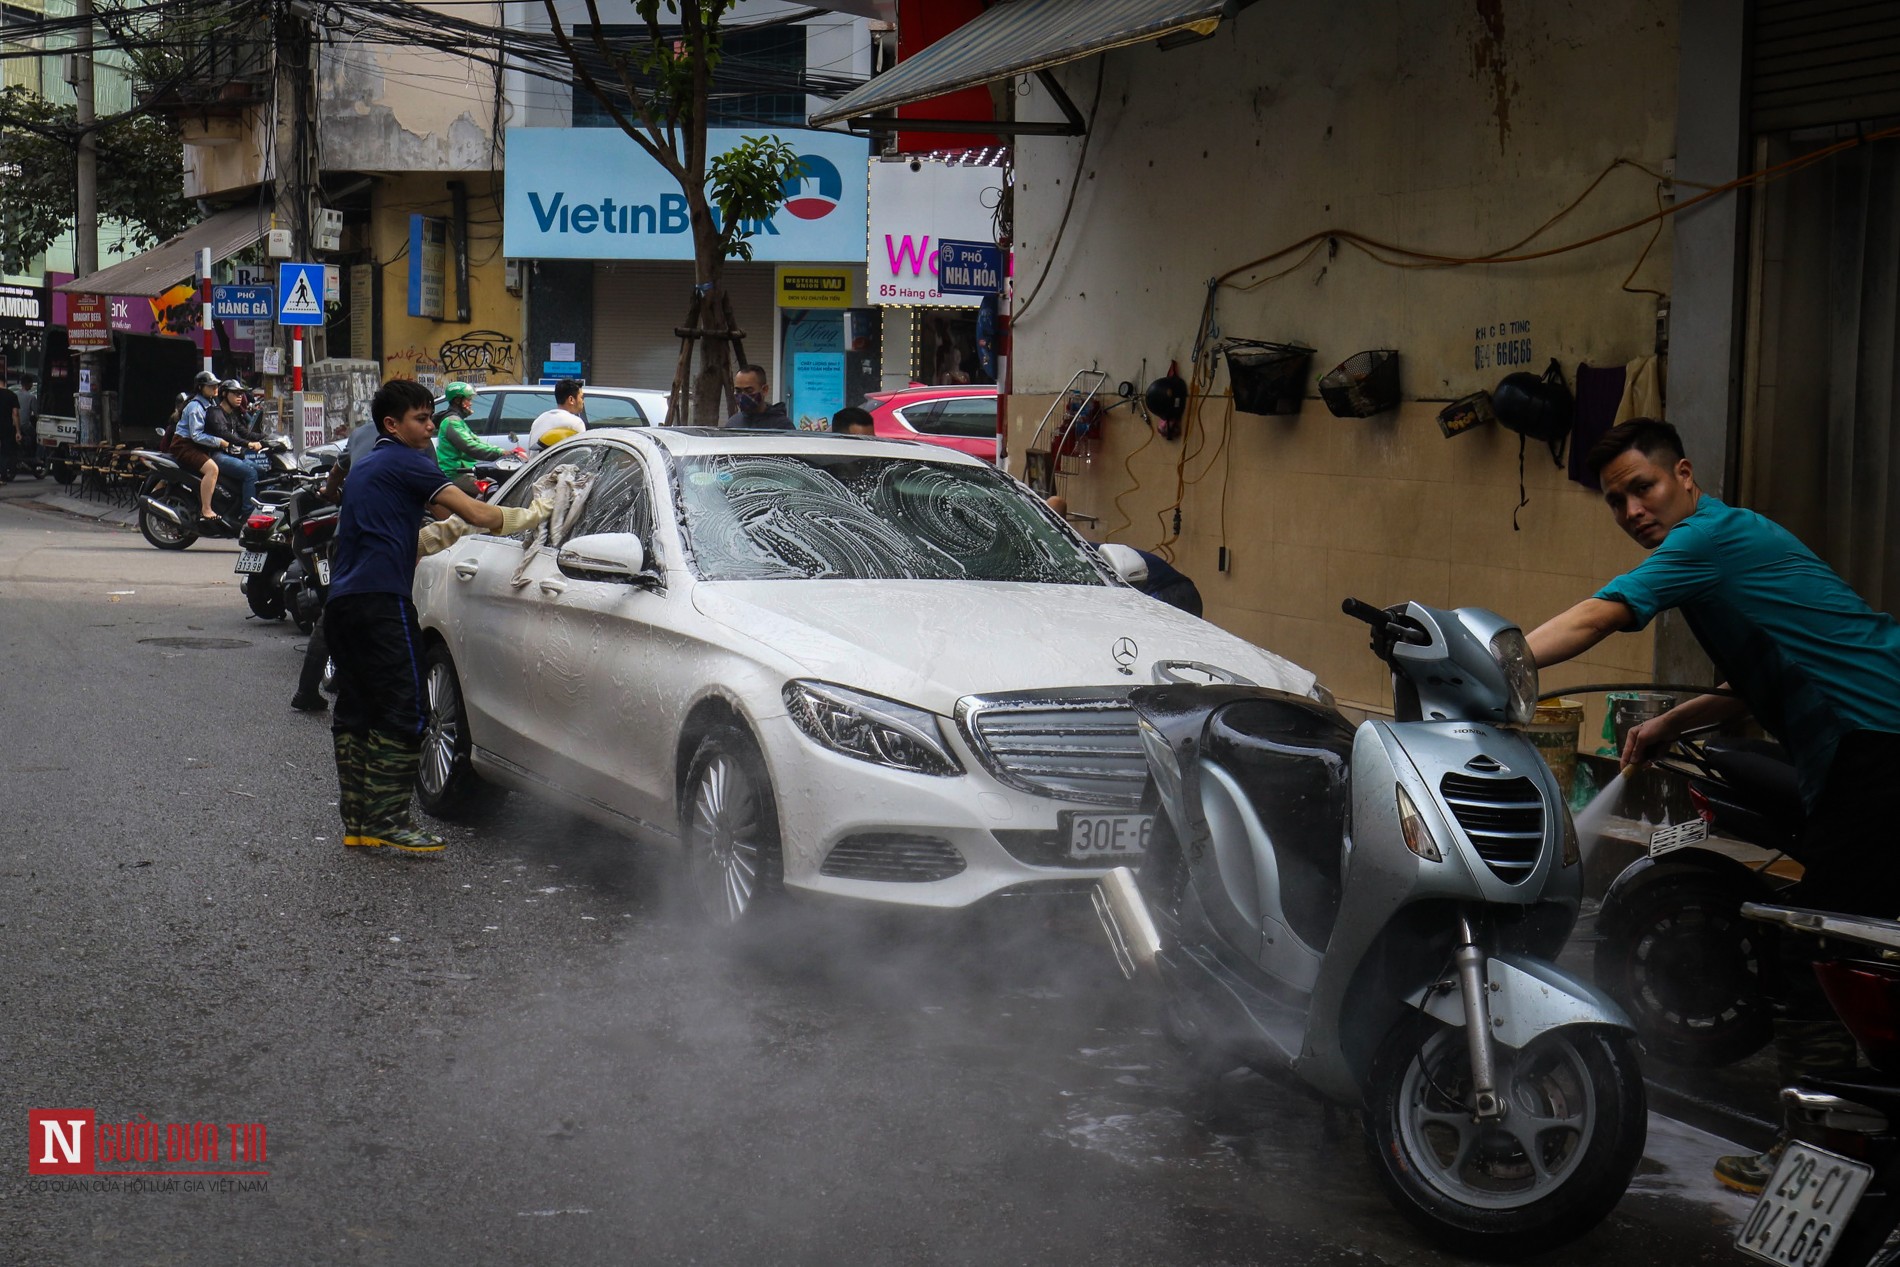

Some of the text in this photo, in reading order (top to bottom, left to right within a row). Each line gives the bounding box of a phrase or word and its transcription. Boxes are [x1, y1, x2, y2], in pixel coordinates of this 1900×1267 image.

[961, 249, 983, 263] PHỐ
[945, 262, 997, 288] NHÀ HỎA
[822, 278, 842, 289] WU
[237, 289, 256, 299] PHỐ
[880, 284, 897, 297] 85
[899, 288, 926, 300] Hàng
[218, 300, 269, 315] HÀNG GÀ
[305, 430, 323, 447] BEER
[1453, 728, 1487, 738] HONDA
